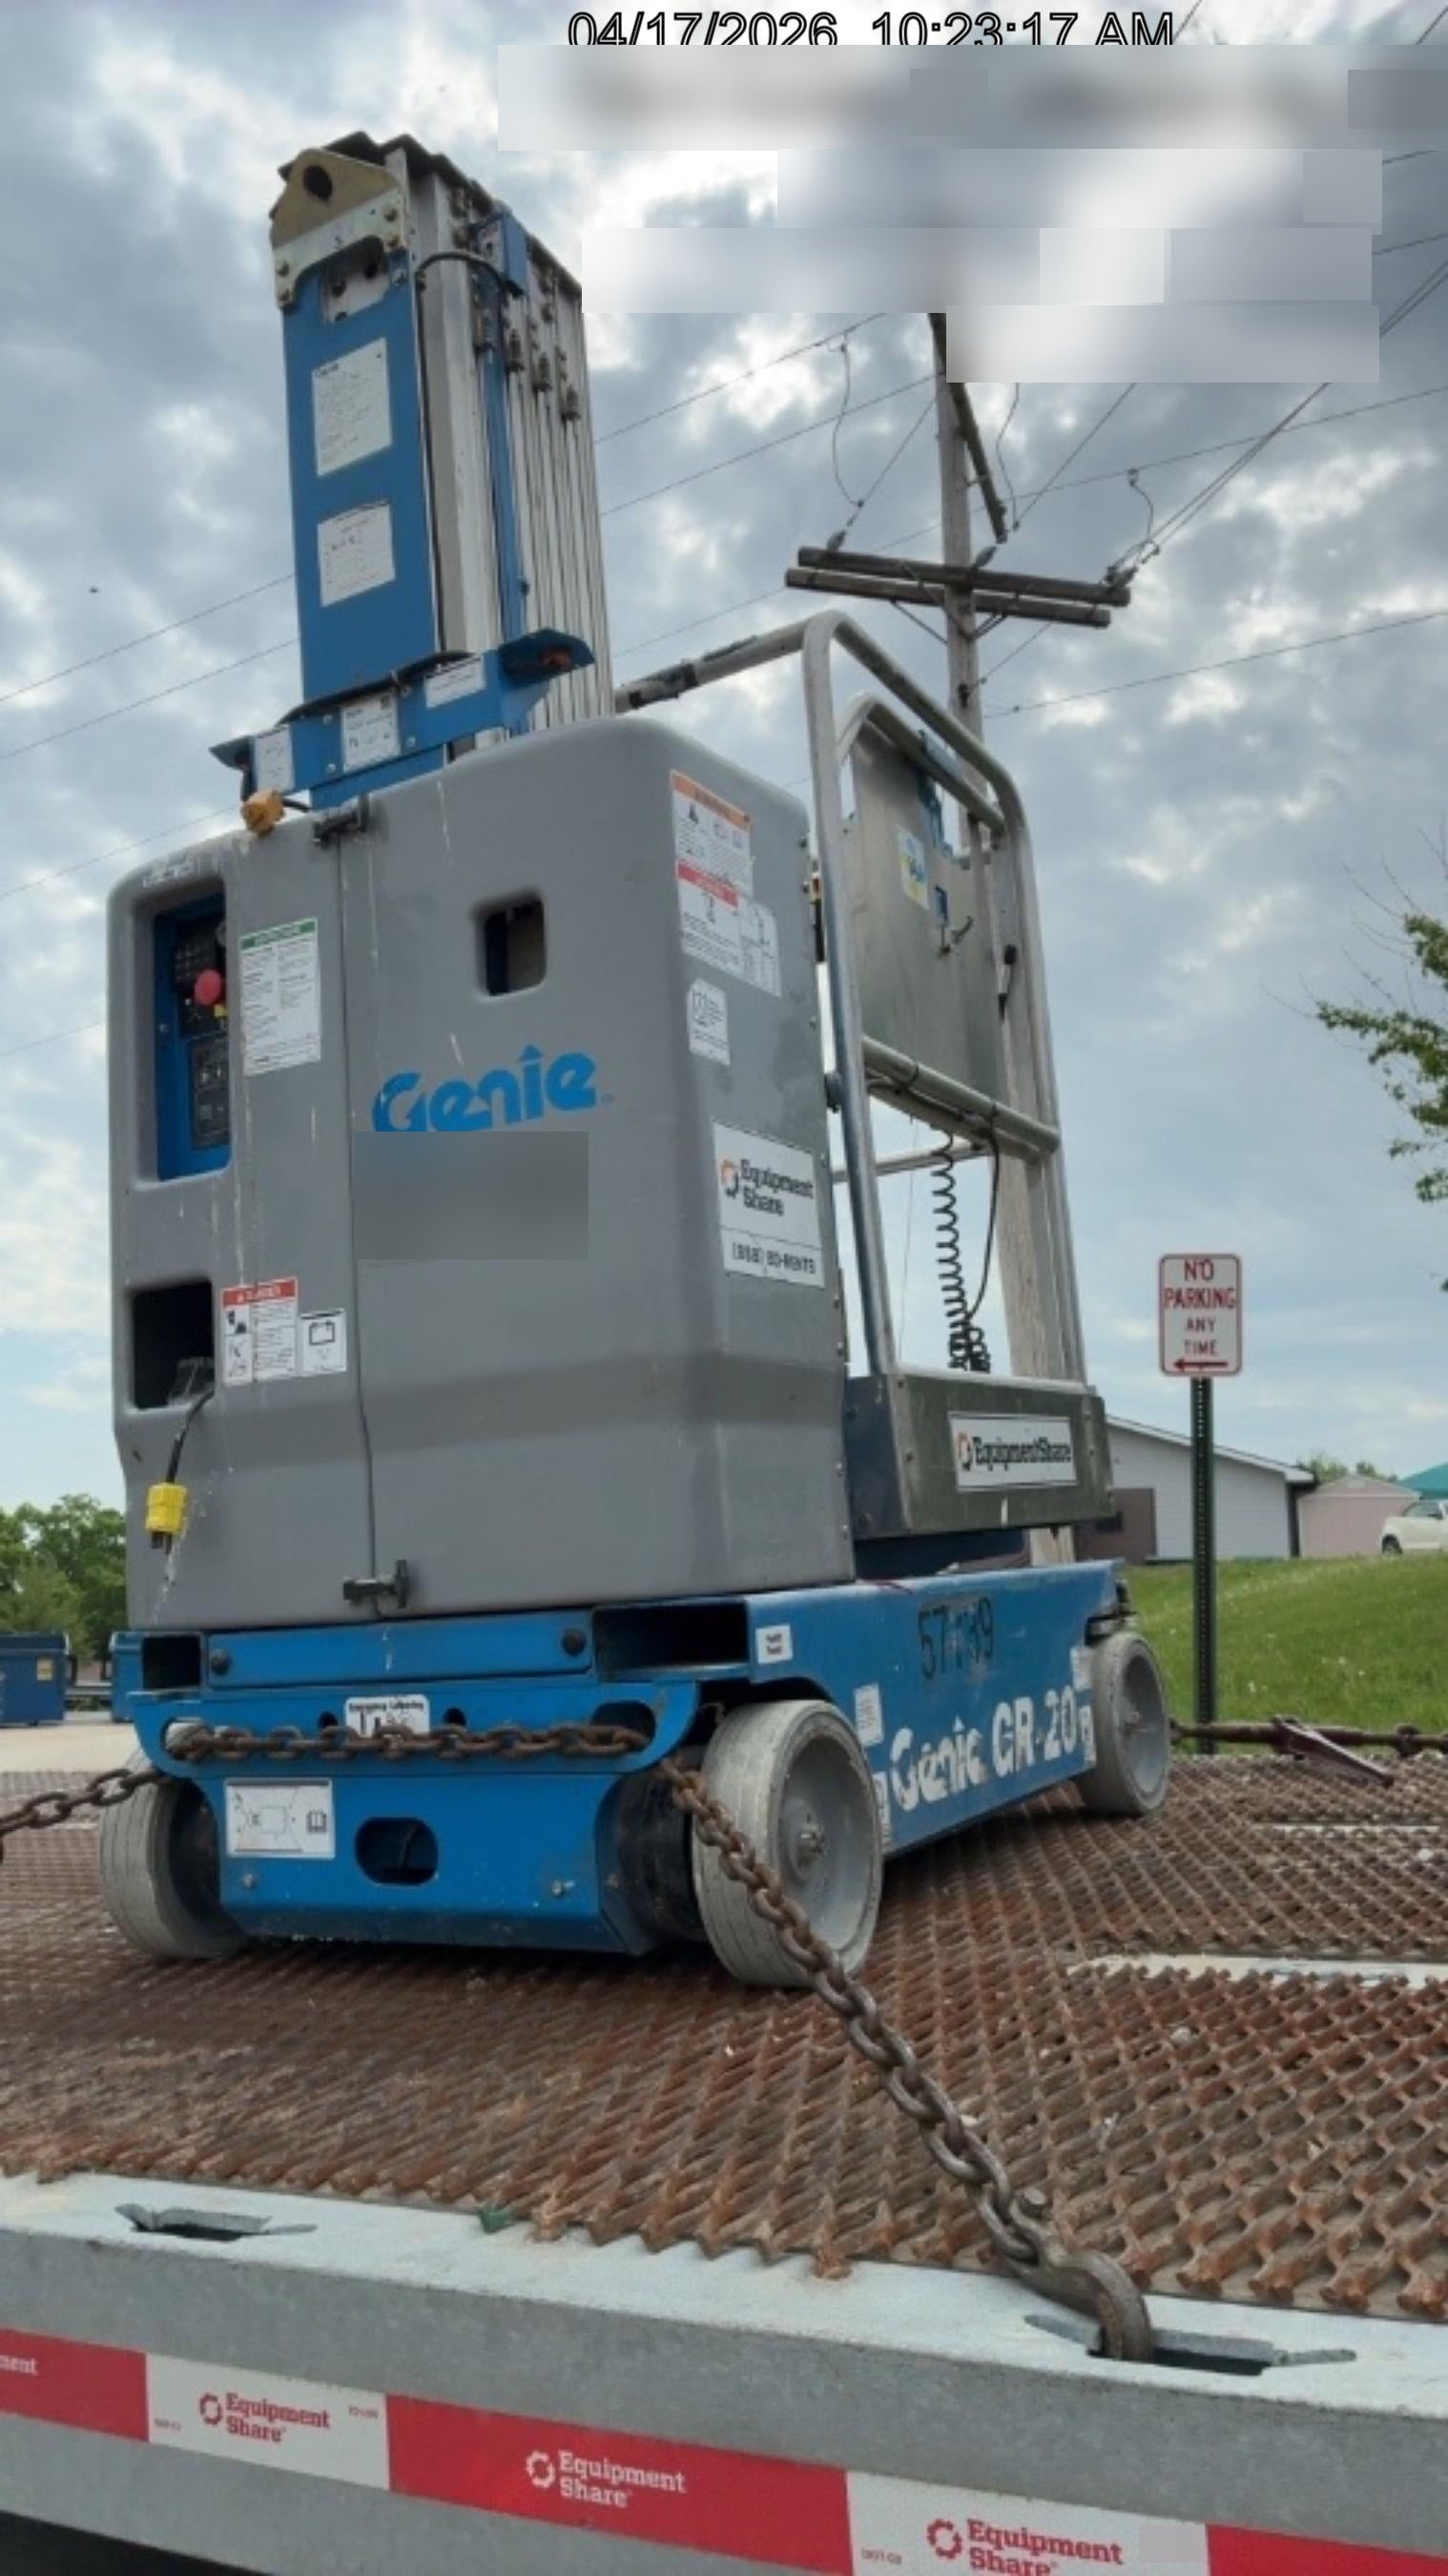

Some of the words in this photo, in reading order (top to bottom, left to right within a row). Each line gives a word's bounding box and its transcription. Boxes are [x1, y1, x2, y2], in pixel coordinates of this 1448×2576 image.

[372, 1044, 597, 1132] Genie
[739, 1158, 815, 1199] Equipment
[743, 1186, 785, 1216] Share
[1184, 1258, 1214, 1281] NO
[1163, 1287, 1237, 1309] PARKING
[1186, 1318, 1216, 1332] ANY
[1184, 1339, 1217, 1355] TIME
[972, 1436, 1073, 1472] EquipmentShare
[890, 1714, 989, 1811] Genie
[225, 2392, 331, 2430] Equipment
[225, 2415, 283, 2443] Share
[558, 2449, 687, 2494] Equipment
[560, 2479, 629, 2508] Share
[967, 2518, 1125, 2566] Equipment
[969, 2547, 1052, 2576] Share
